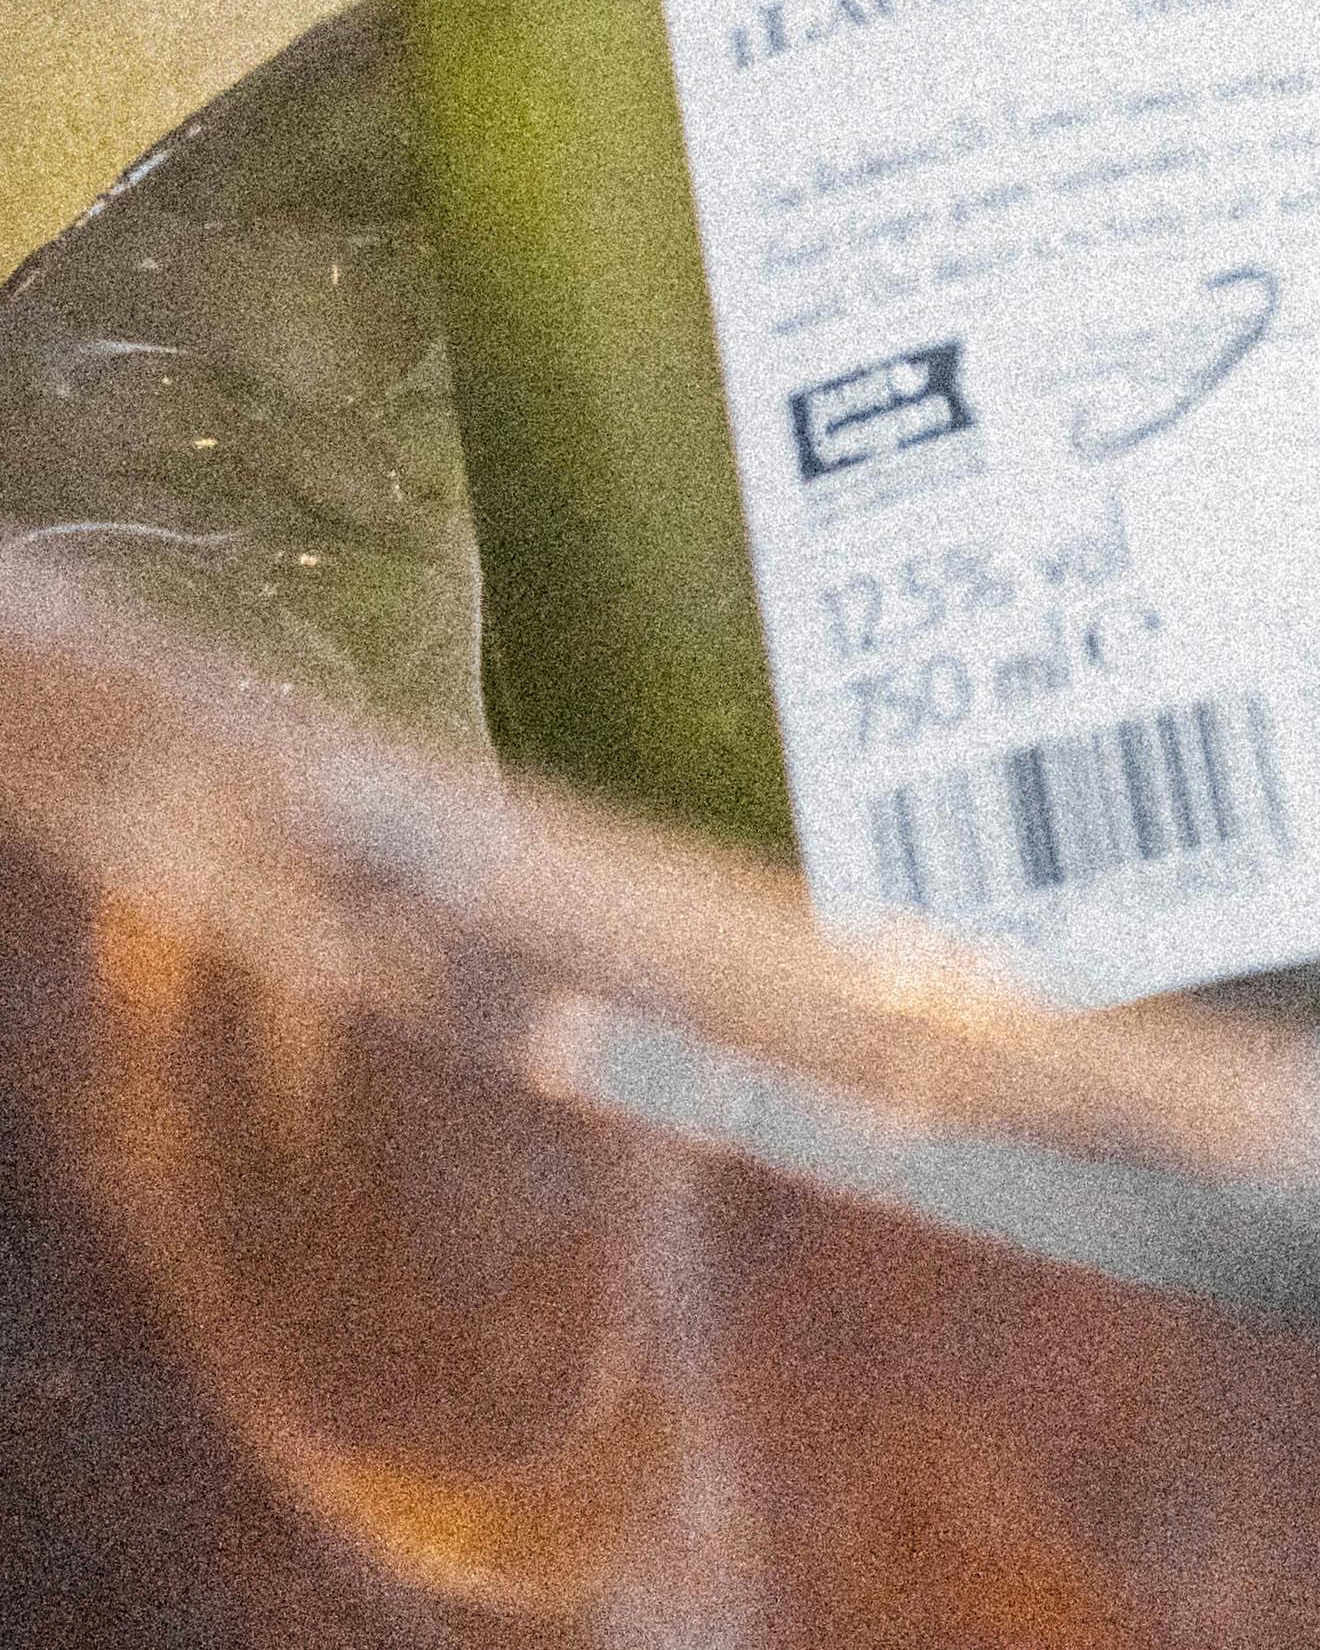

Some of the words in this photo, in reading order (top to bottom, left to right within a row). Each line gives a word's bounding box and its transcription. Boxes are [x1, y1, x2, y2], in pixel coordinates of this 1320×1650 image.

[1040, 497, 1132, 584] vol
[845, 655, 973, 750] 750
[997, 609, 1072, 701] ml
